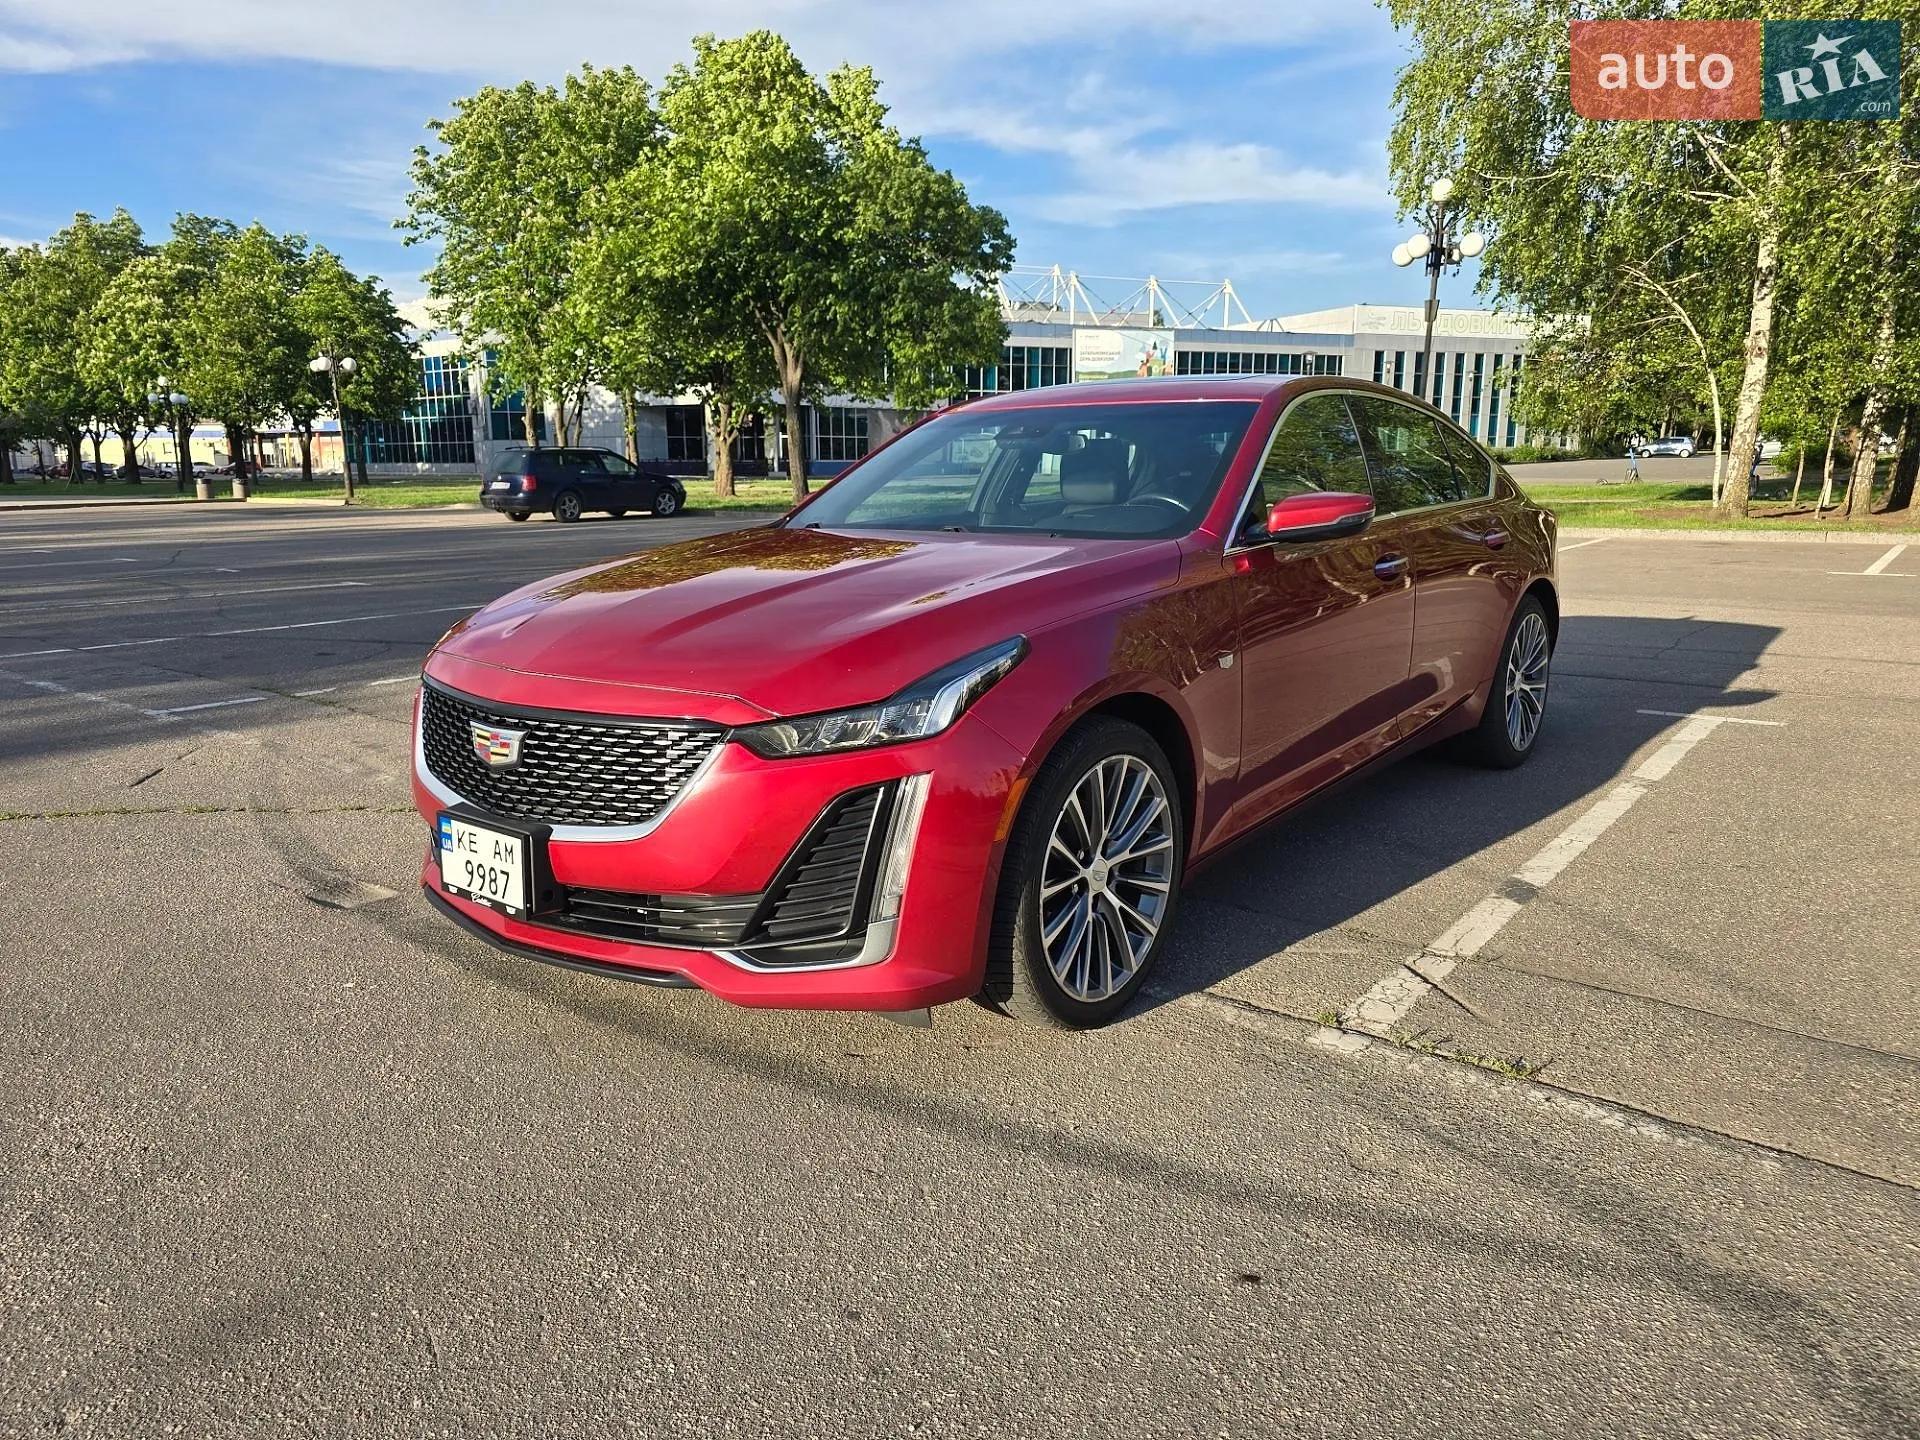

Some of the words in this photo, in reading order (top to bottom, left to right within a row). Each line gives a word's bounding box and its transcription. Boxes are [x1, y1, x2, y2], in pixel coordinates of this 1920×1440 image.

[1390, 310, 1513, 336] ЛЬДОВИЙ
[441, 837, 453, 850] UA
[456, 828, 478, 854] KE
[493, 839, 515, 865] AM
[464, 859, 510, 900] 9987
